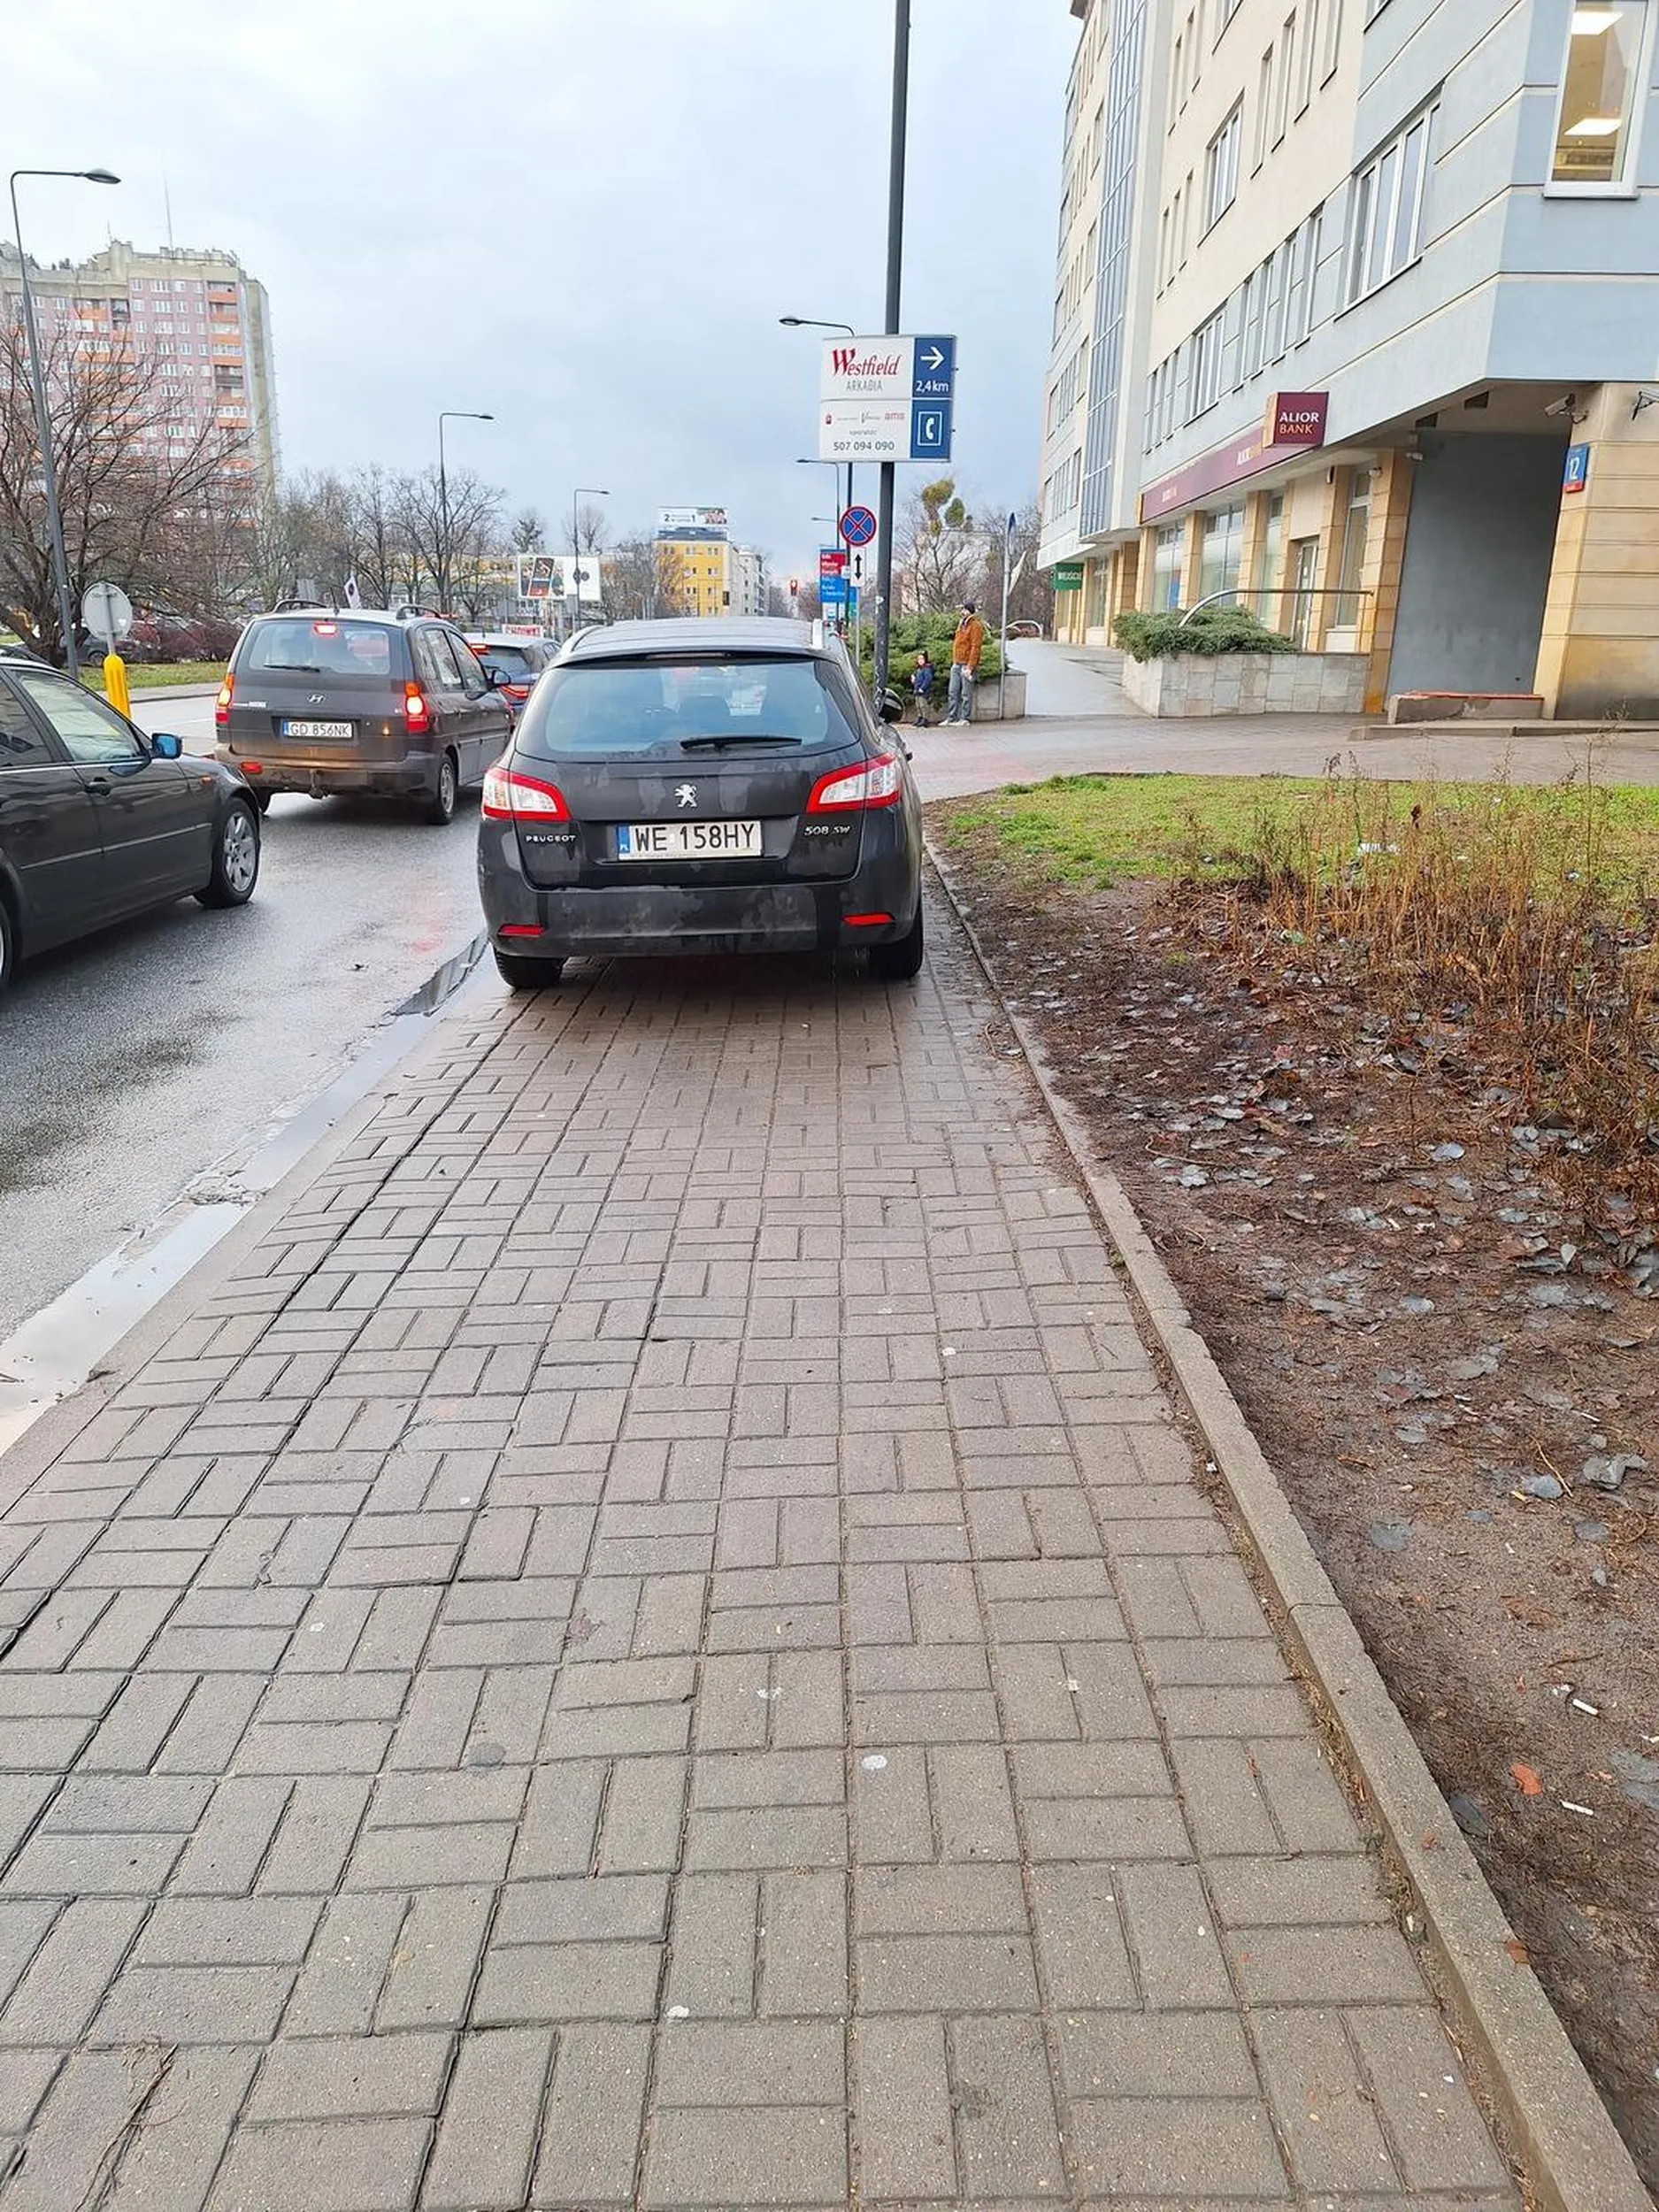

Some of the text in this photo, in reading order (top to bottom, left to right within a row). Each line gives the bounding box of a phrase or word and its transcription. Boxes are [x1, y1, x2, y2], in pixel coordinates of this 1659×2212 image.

[832, 348, 902, 376] Westfield
[846, 380, 883, 391] ARKADIA
[916, 380, 949, 393] 2,4 km
[1279, 411, 1319, 423] ALIOR
[1279, 424, 1314, 434] BANK
[833, 441, 895, 450] 507 094 090
[290, 723, 349, 736] GD 856NK
[804, 825, 850, 836] 508 SW
[634, 823, 755, 852] WE 158HY
